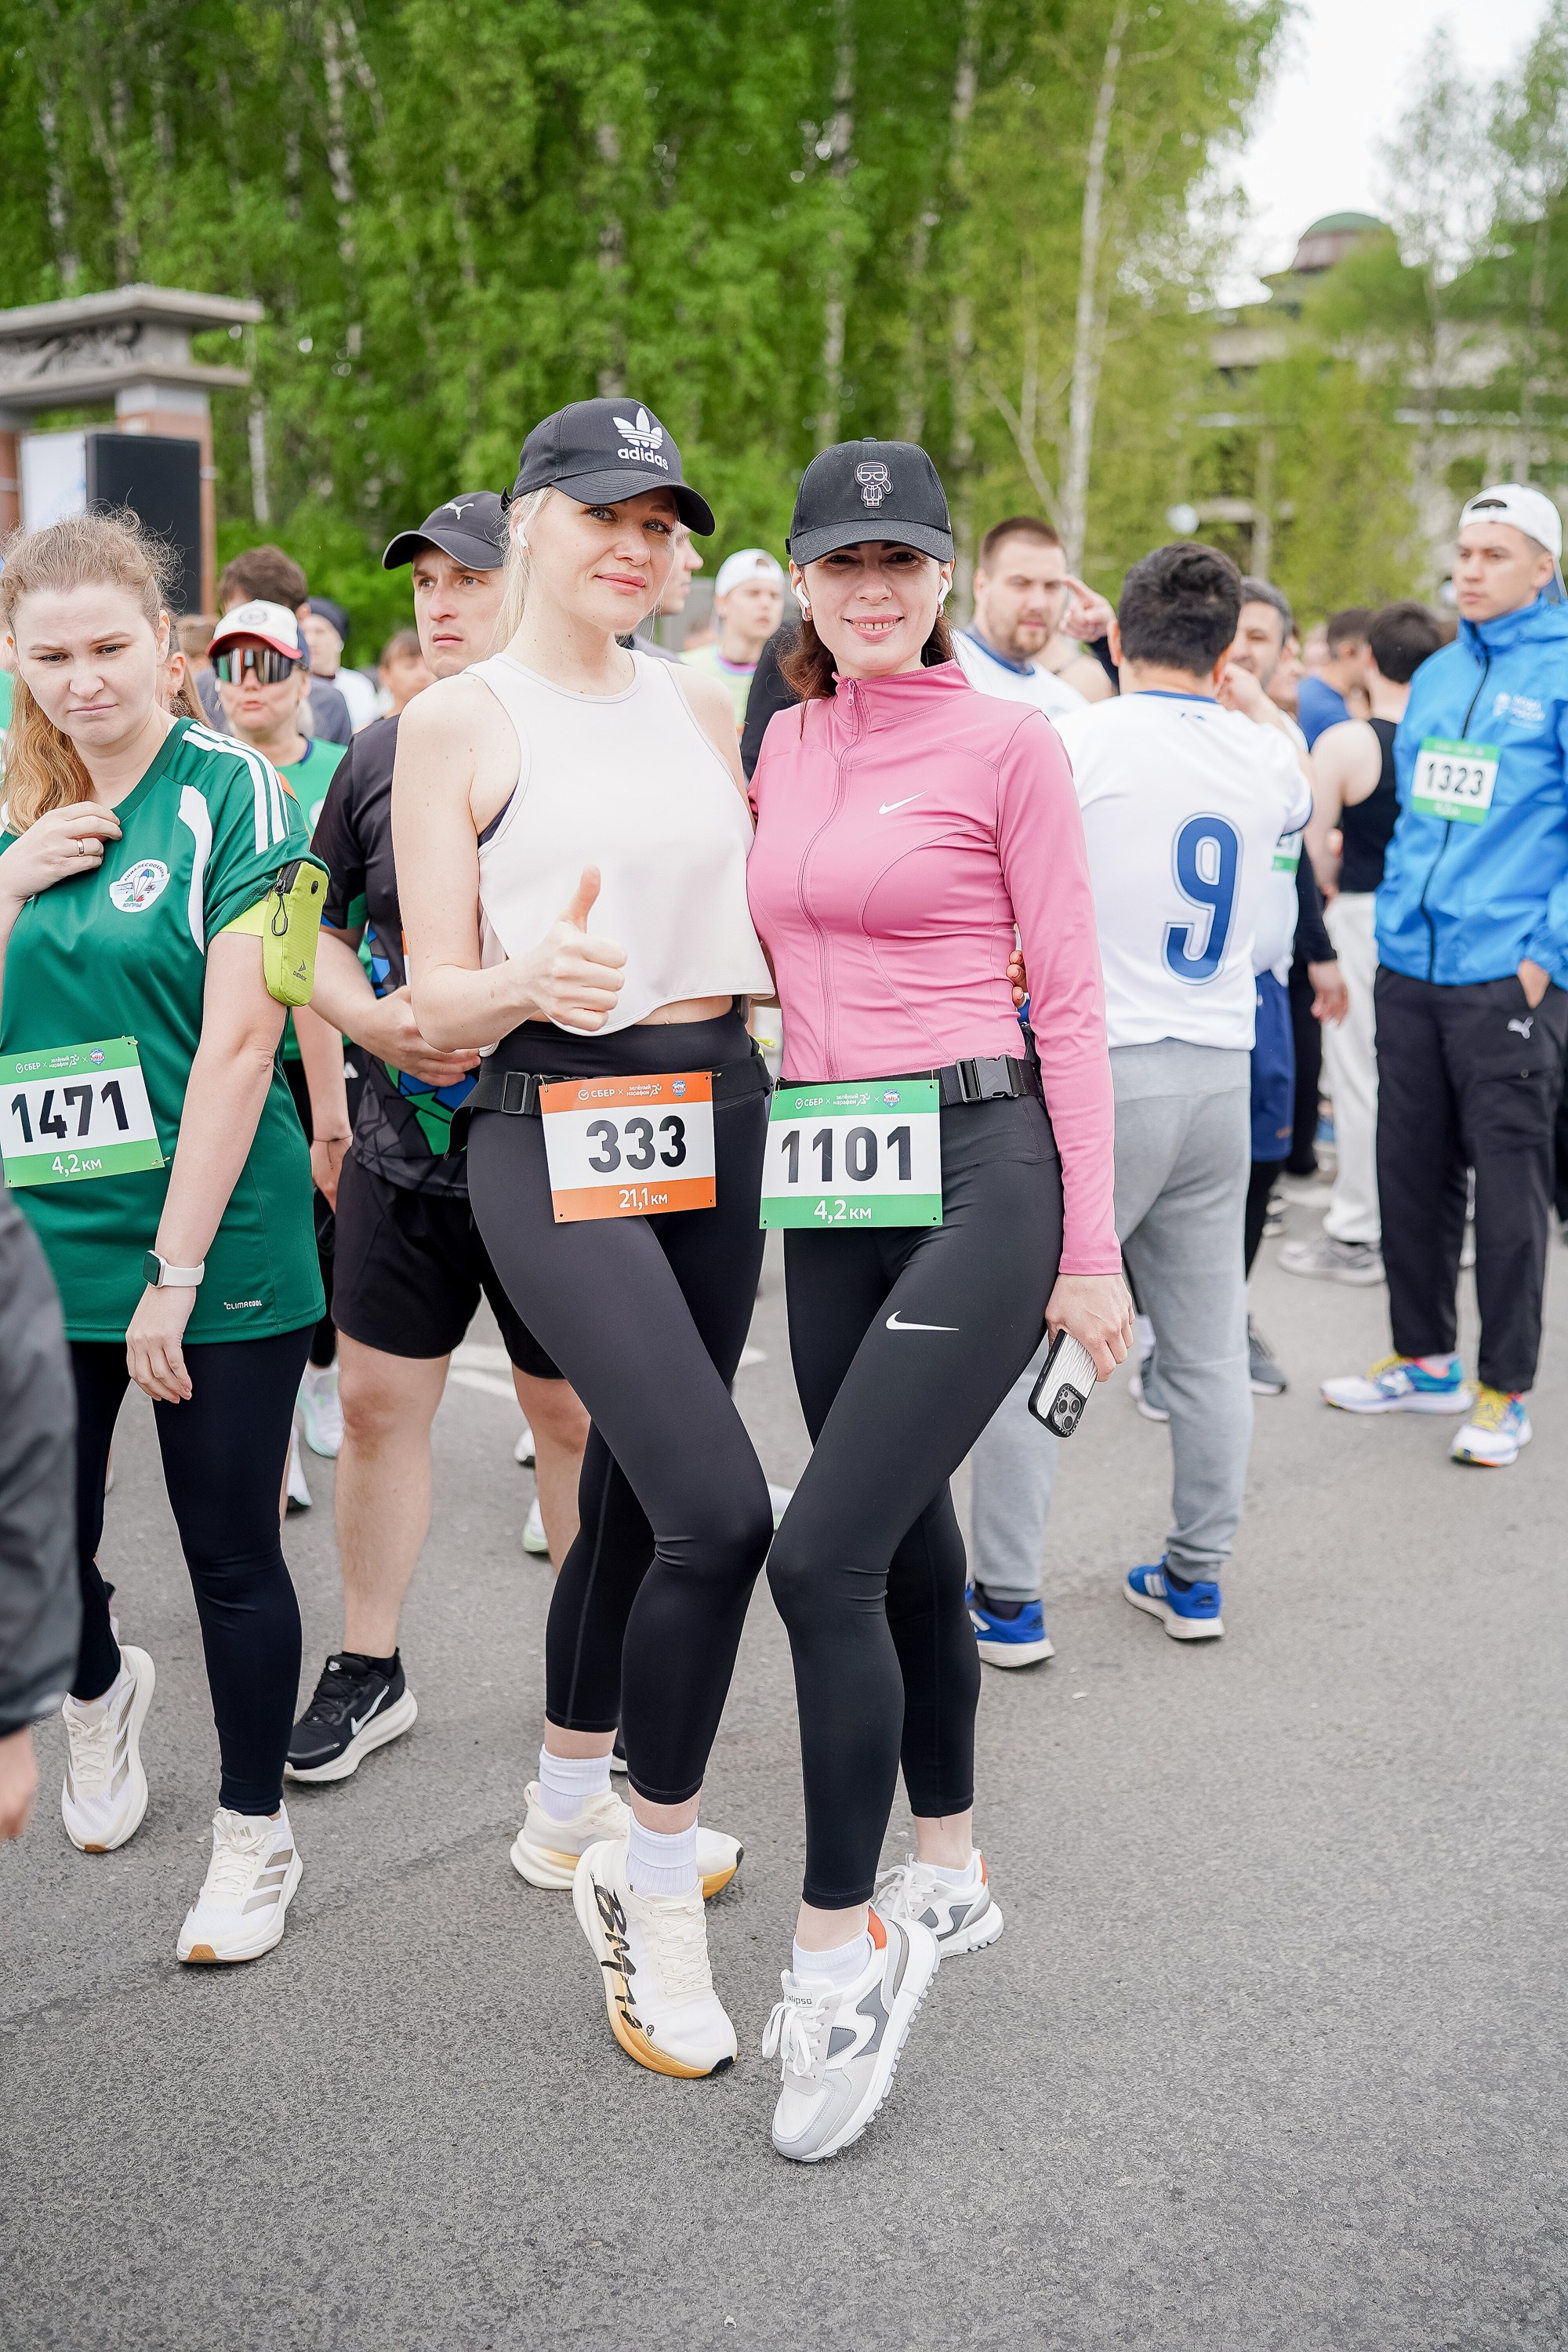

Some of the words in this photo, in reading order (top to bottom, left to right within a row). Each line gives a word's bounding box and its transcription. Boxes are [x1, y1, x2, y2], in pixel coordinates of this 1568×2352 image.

[618, 447, 669, 470] adidas
[1427, 763, 1484, 796] 1323
[1163, 814, 1243, 983] 9
[24, 1062, 41, 1071] СБЕР
[591, 1089, 615, 1098] СБЕР
[804, 1098, 823, 1106] СБЕР
[11, 1080, 129, 1143] 1471
[586, 1115, 687, 1173] 333
[782, 1126, 912, 1183] 1101
